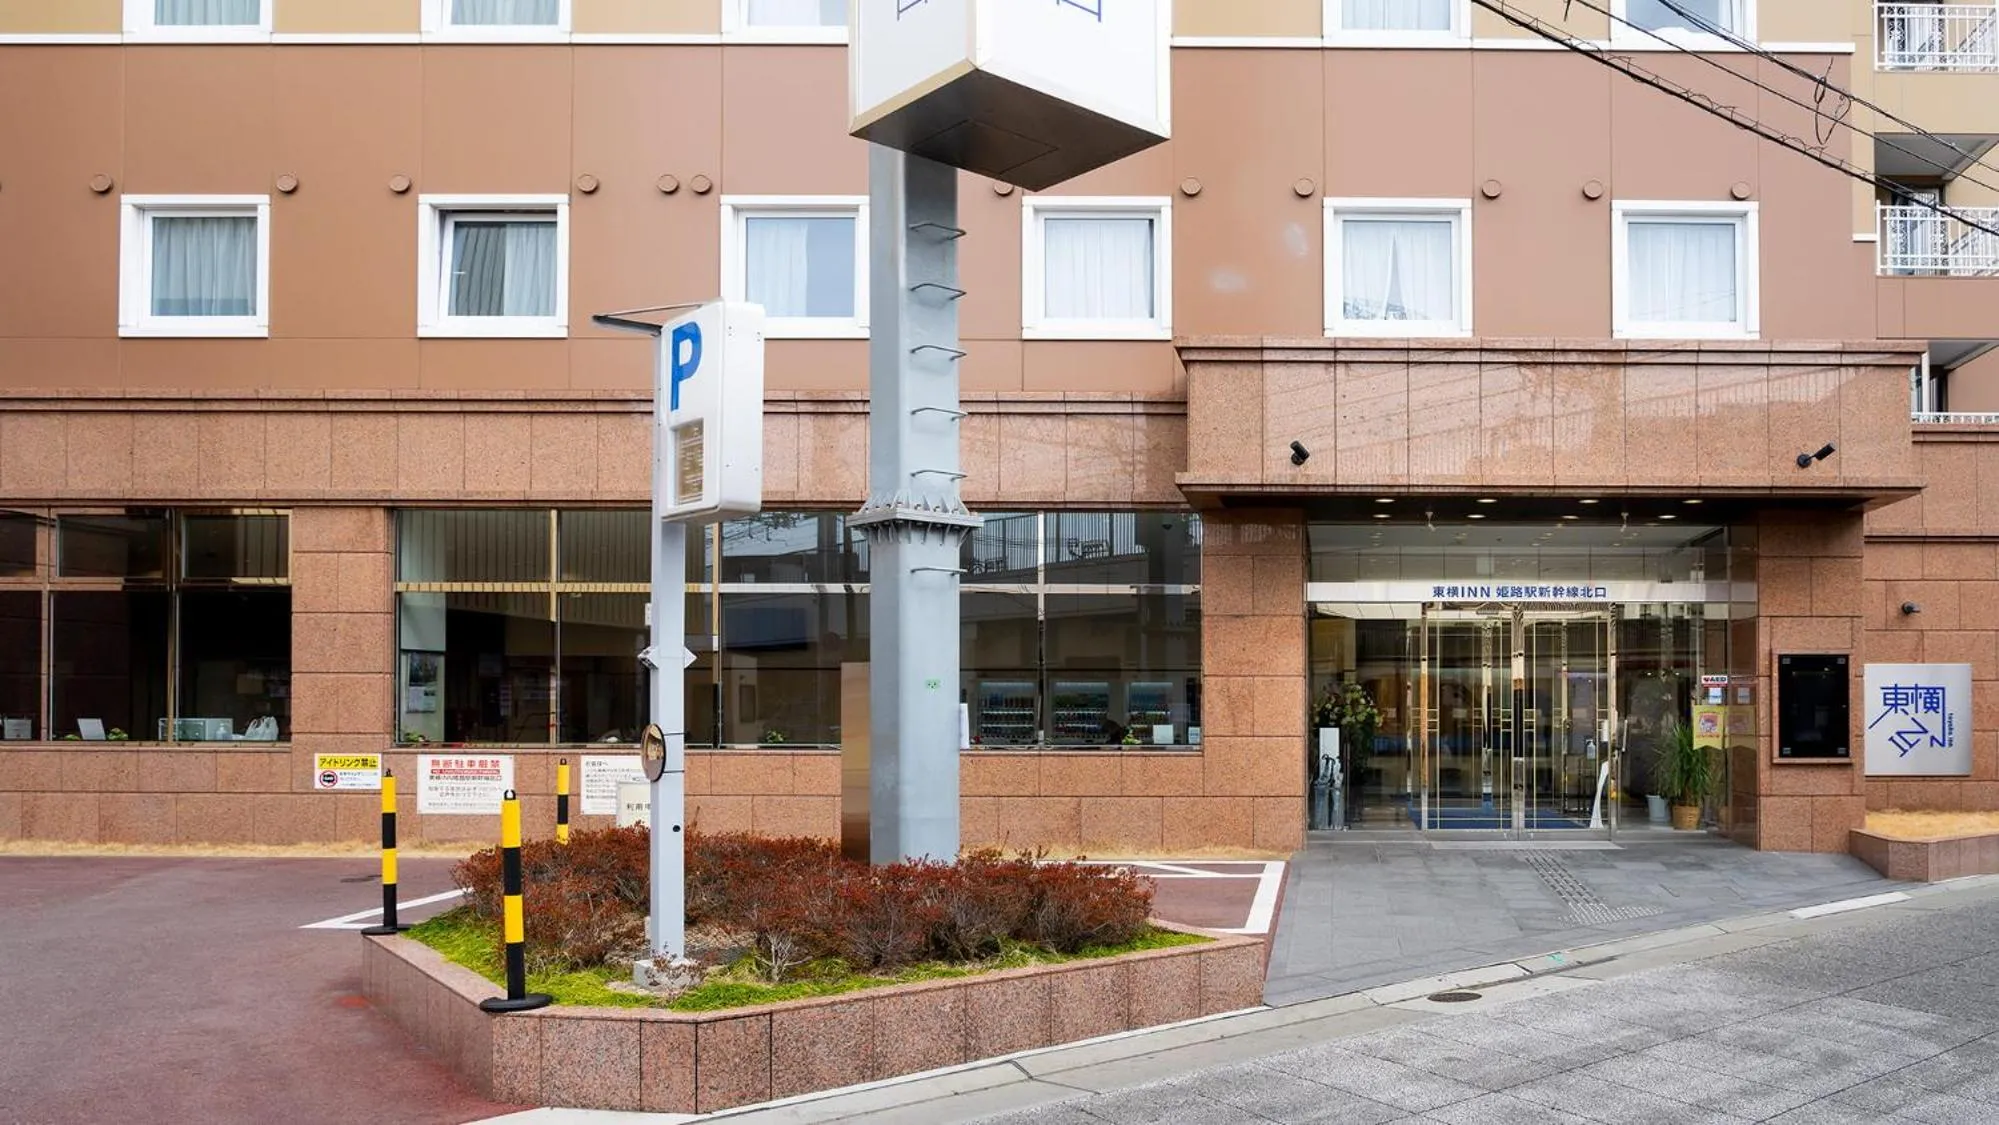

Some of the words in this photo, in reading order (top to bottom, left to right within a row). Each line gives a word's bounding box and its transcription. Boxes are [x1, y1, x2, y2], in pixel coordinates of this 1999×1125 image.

[671, 321, 702, 411] P
[1432, 585, 1491, 598] 東横INN
[1496, 585, 1607, 598] 姫路駅新幹線北口
